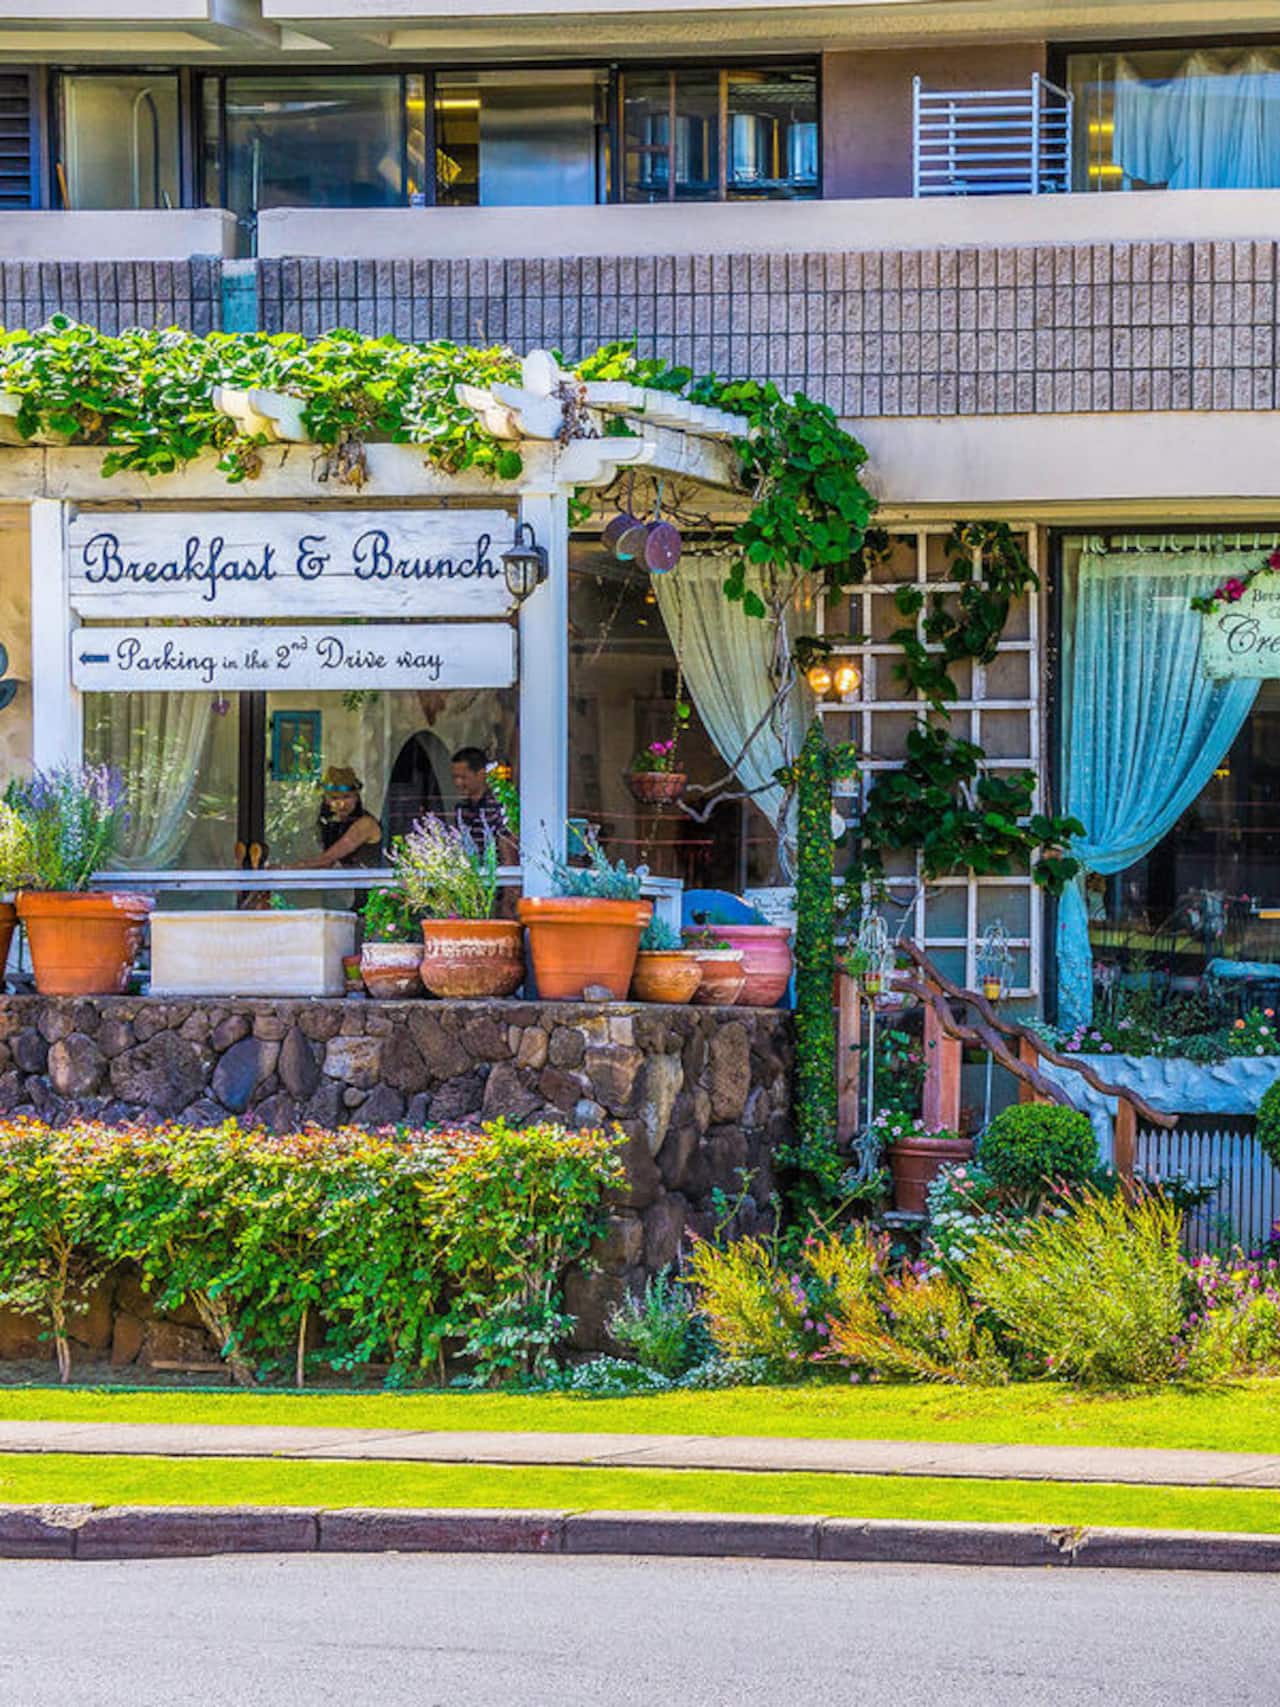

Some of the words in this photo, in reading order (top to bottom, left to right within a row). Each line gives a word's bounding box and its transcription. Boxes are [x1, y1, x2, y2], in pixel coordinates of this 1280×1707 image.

[83, 533, 277, 601] Breakfast
[297, 535, 330, 580] &
[353, 530, 499, 580] Brunch
[117, 638, 217, 683] Parking
[222, 656, 238, 669] in
[244, 650, 269, 669] the
[276, 635, 308, 669] 2nd
[316, 636, 387, 669] Drive
[396, 651, 444, 681] way
